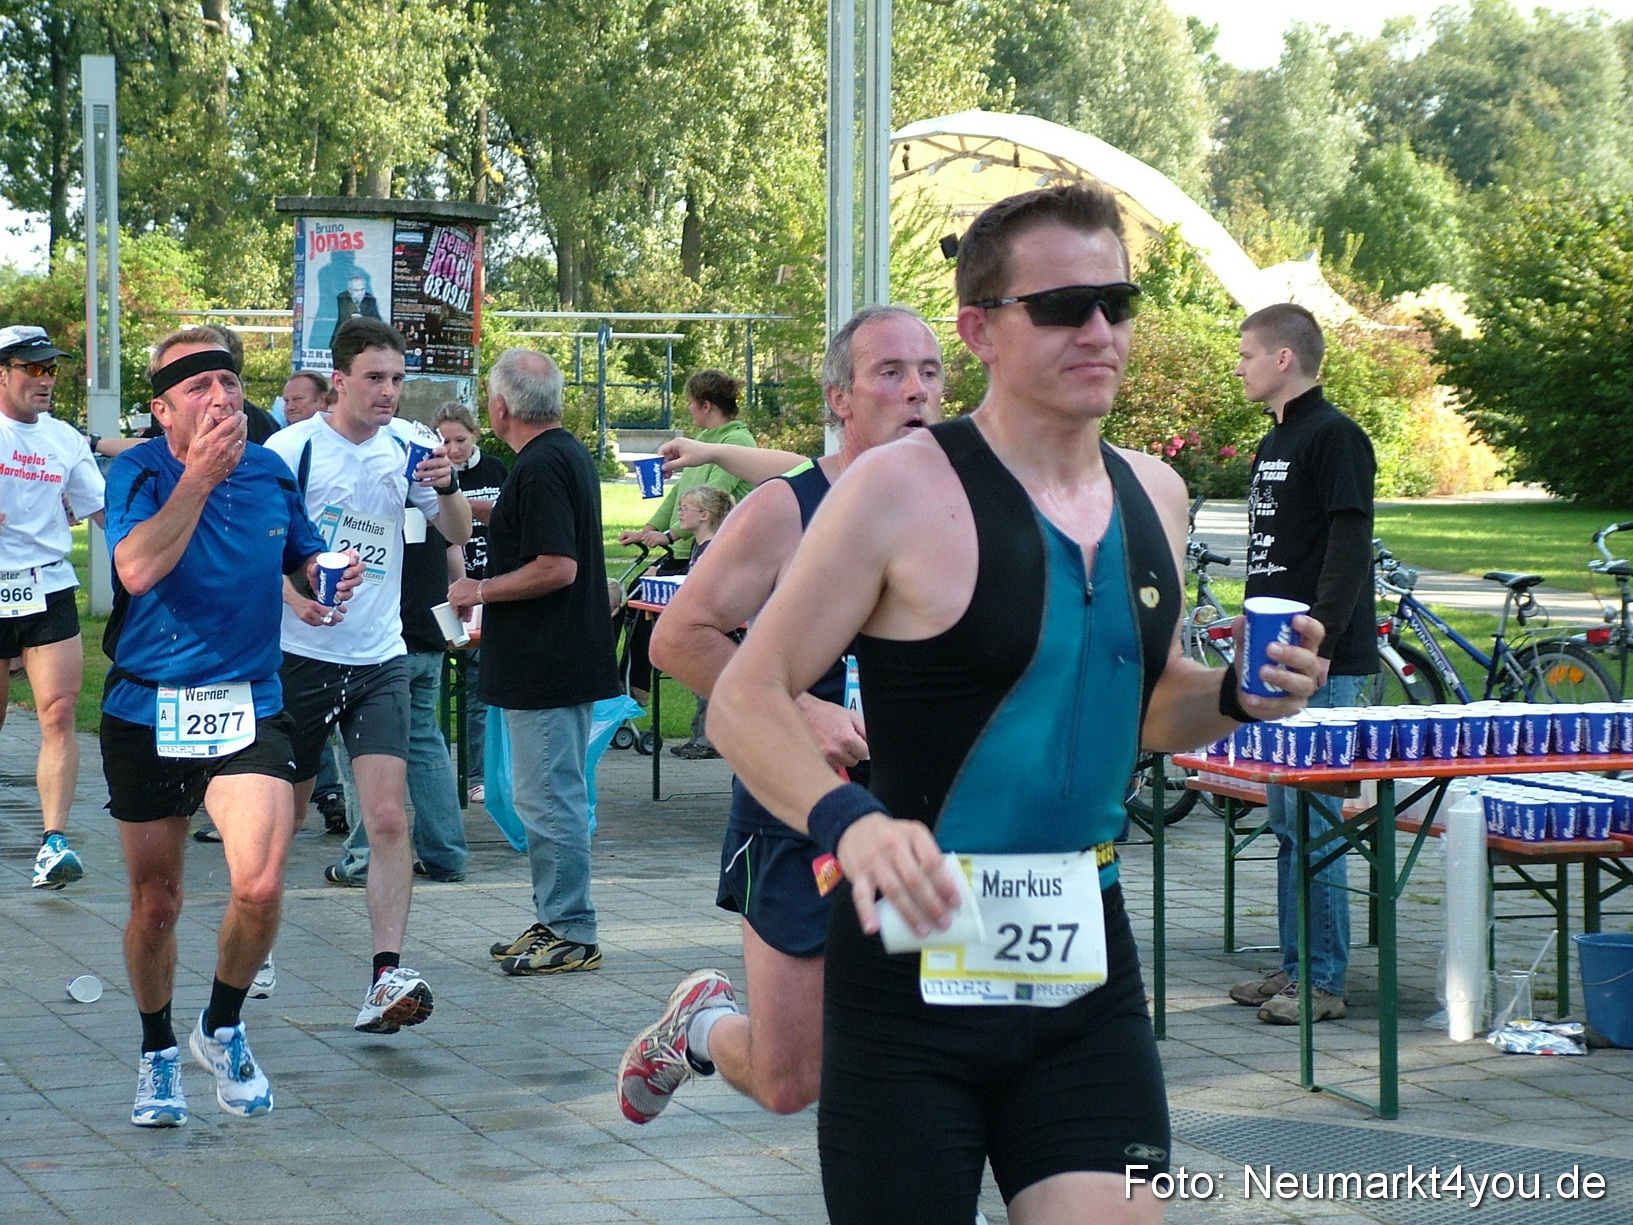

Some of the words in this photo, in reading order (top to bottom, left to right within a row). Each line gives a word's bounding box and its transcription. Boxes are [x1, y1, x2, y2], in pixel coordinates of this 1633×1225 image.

[315, 222, 345, 235] Bruno
[309, 230, 365, 261] Jonas
[429, 247, 475, 293] ROCK
[12, 450, 46, 467] Angelas
[342, 515, 386, 536] Matthias
[337, 539, 387, 566] 2122
[0, 571, 20, 581] eter
[0, 586, 33, 603] 966
[185, 687, 229, 702] Werner
[161, 709, 167, 721] A
[187, 711, 245, 735] 2877
[982, 869, 1063, 898] Markus
[993, 923, 1080, 963] 257
